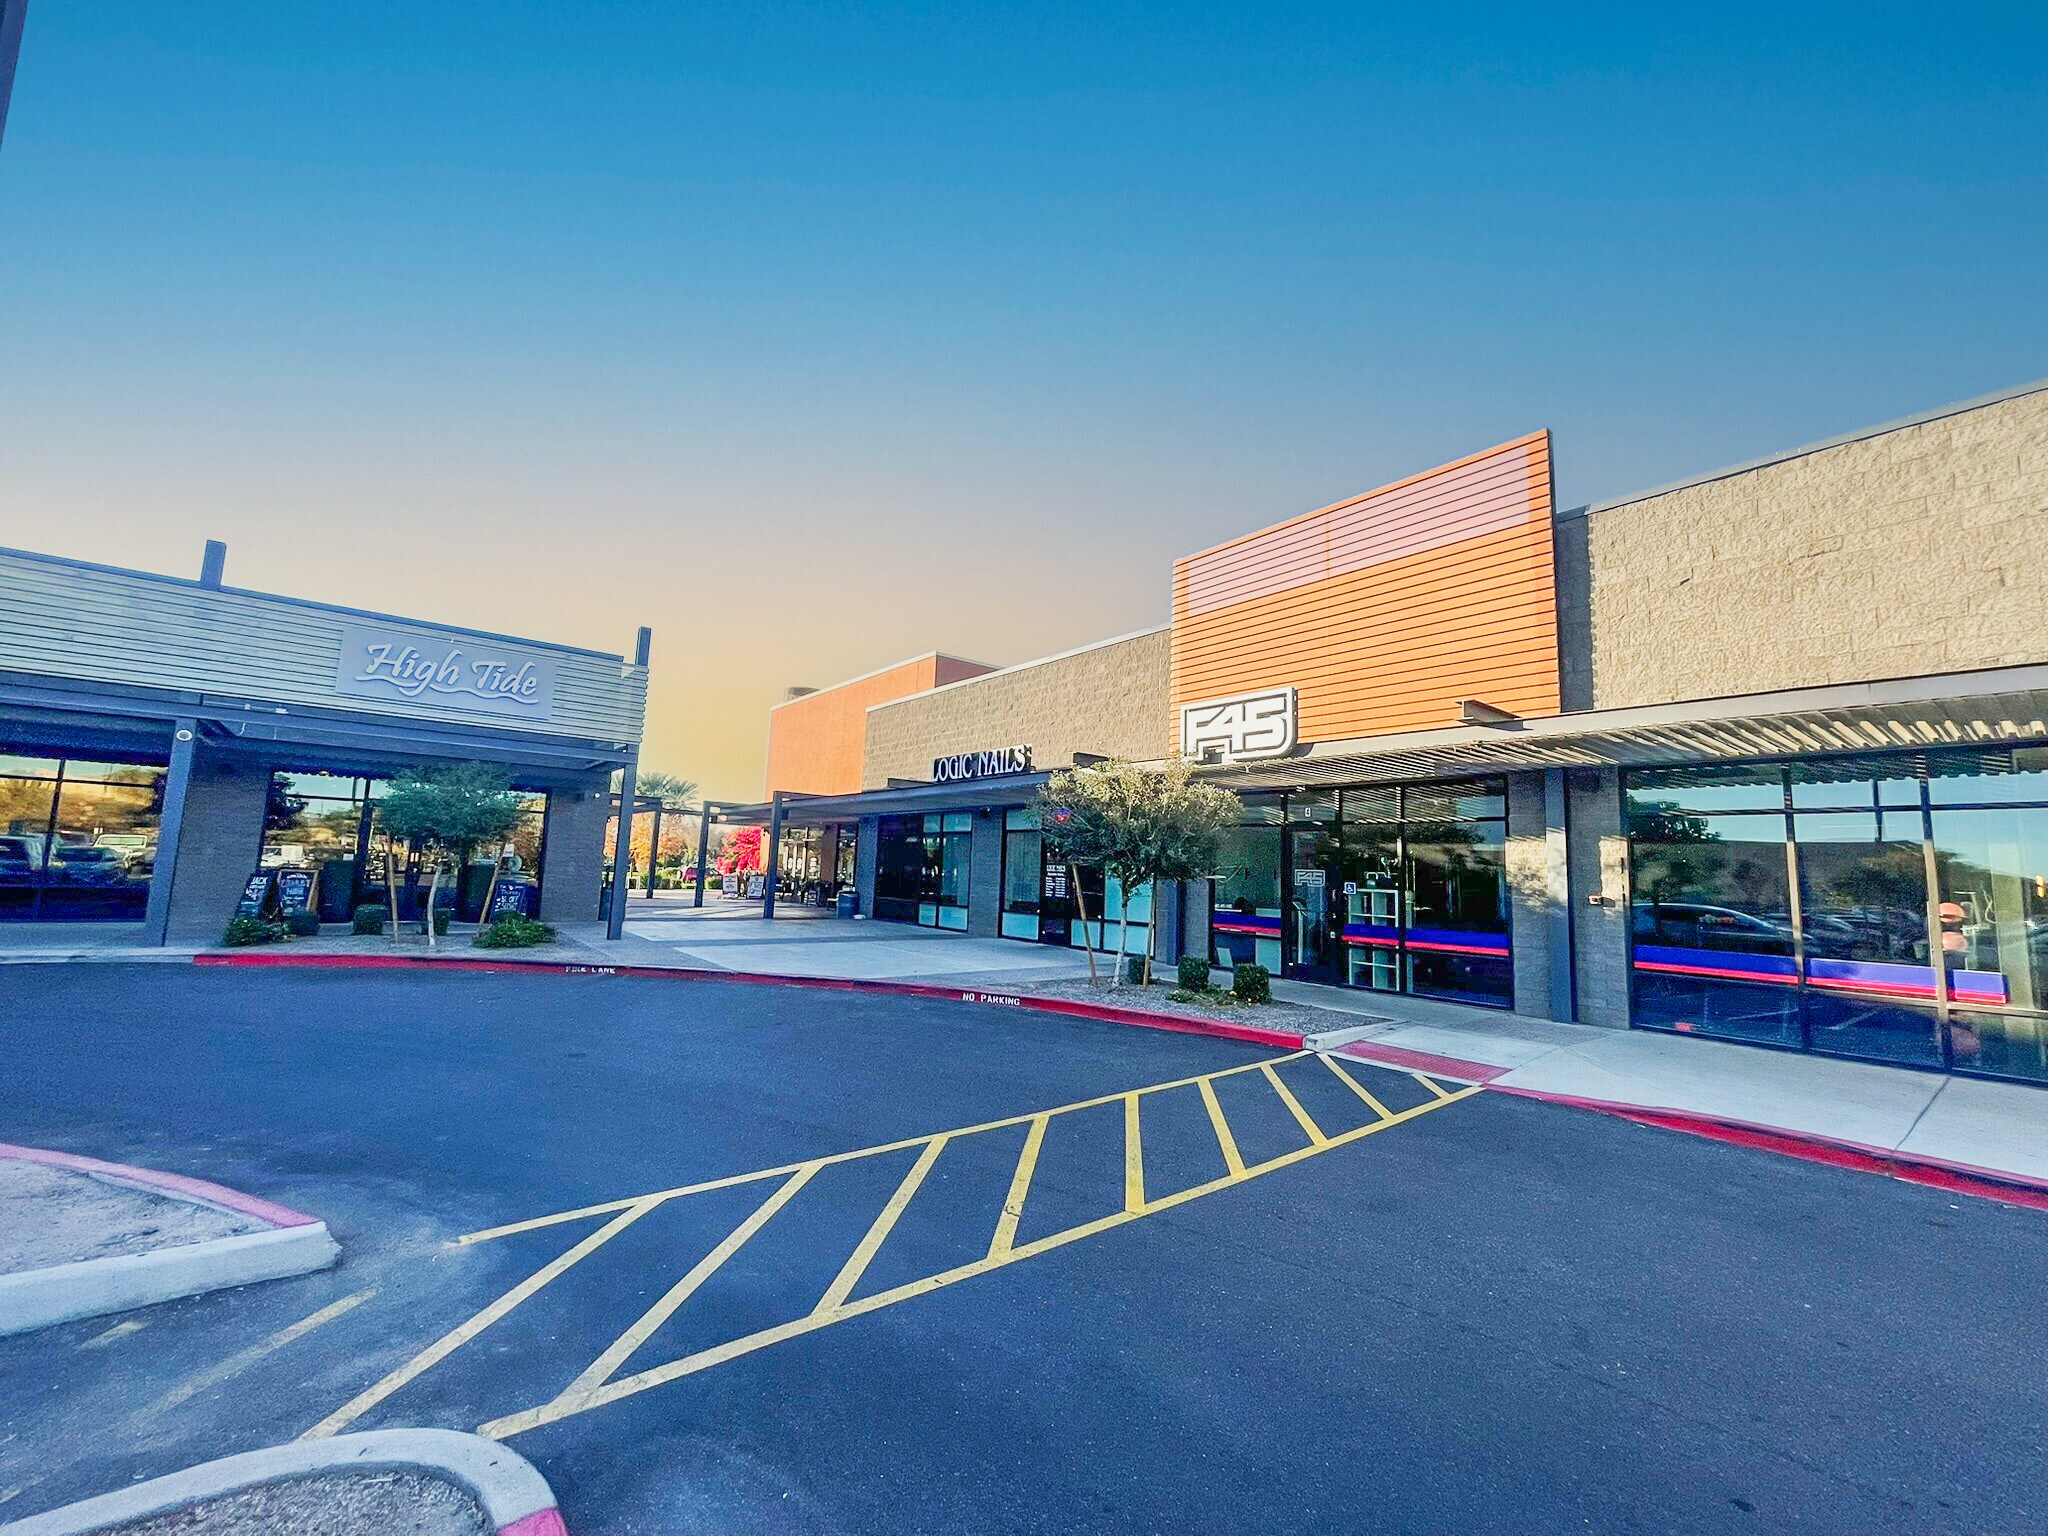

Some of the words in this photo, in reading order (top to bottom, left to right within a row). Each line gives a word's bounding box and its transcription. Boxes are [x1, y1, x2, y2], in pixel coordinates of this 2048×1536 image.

[365, 643, 464, 697] High
[471, 660, 539, 696] Tide
[1186, 694, 1288, 757] F45
[932, 753, 974, 782] LOGIC
[976, 744, 1027, 776] NAILS
[1296, 870, 1324, 886] F45
[962, 992, 976, 1002] NO
[980, 994, 1021, 1006] PARKING
